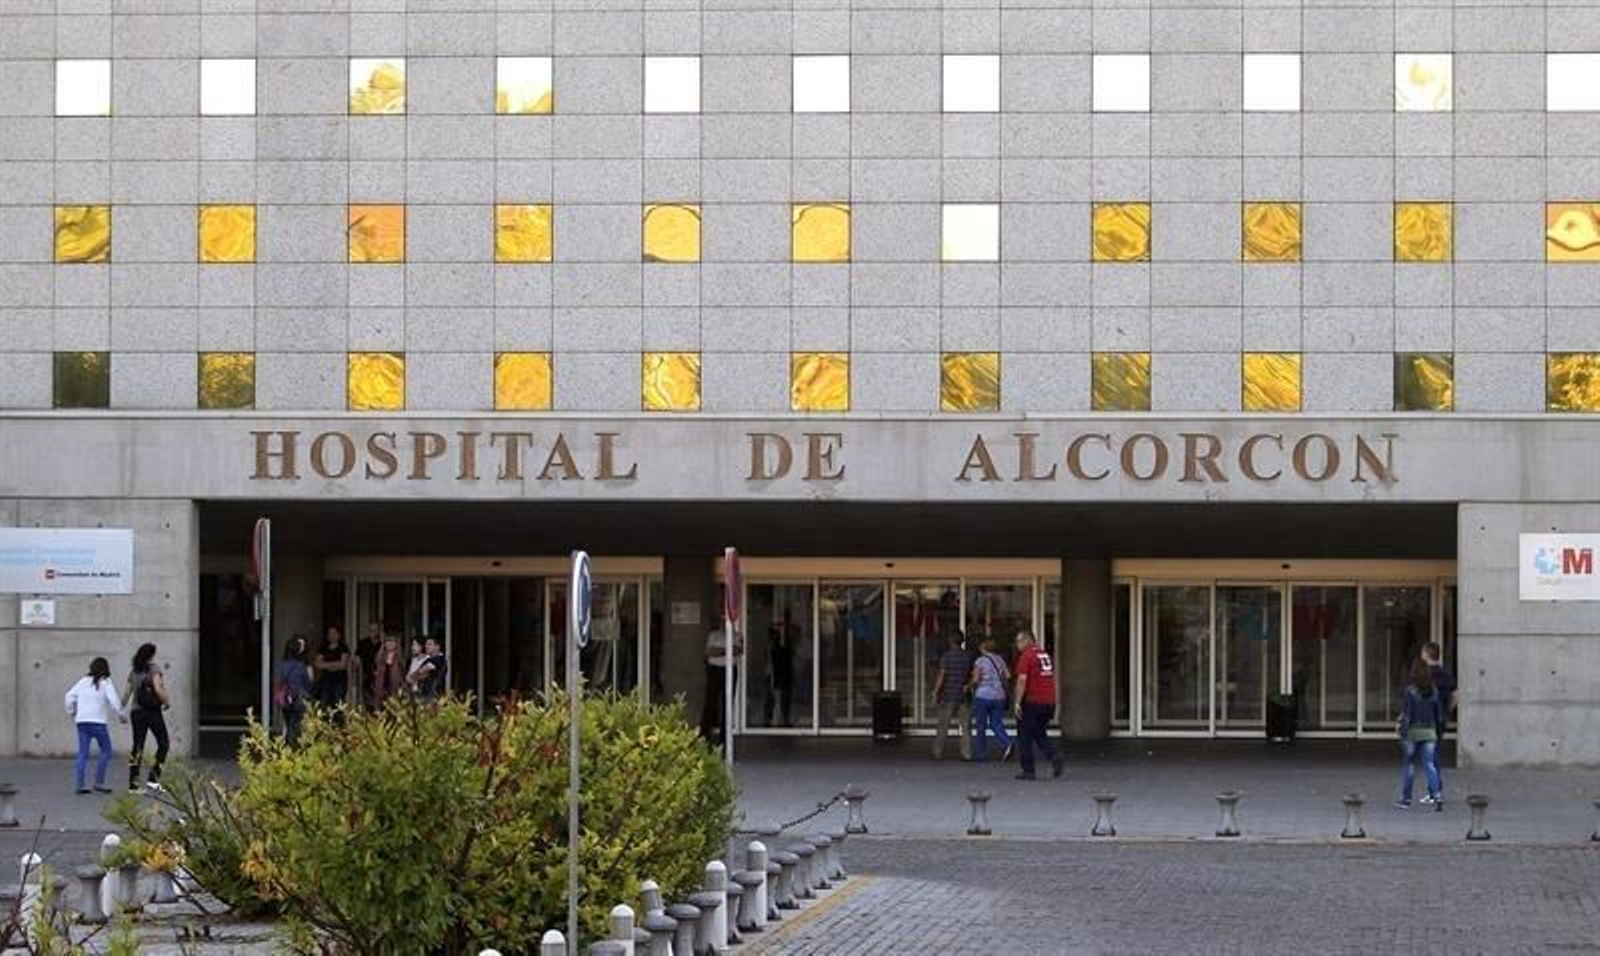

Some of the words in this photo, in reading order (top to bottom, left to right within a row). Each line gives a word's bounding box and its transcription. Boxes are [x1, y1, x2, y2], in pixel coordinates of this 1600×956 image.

[249, 430, 638, 480] HOSPITAL
[746, 433, 846, 480] DE
[955, 433, 1399, 481] ALCORCON
[1563, 548, 1593, 575] M
